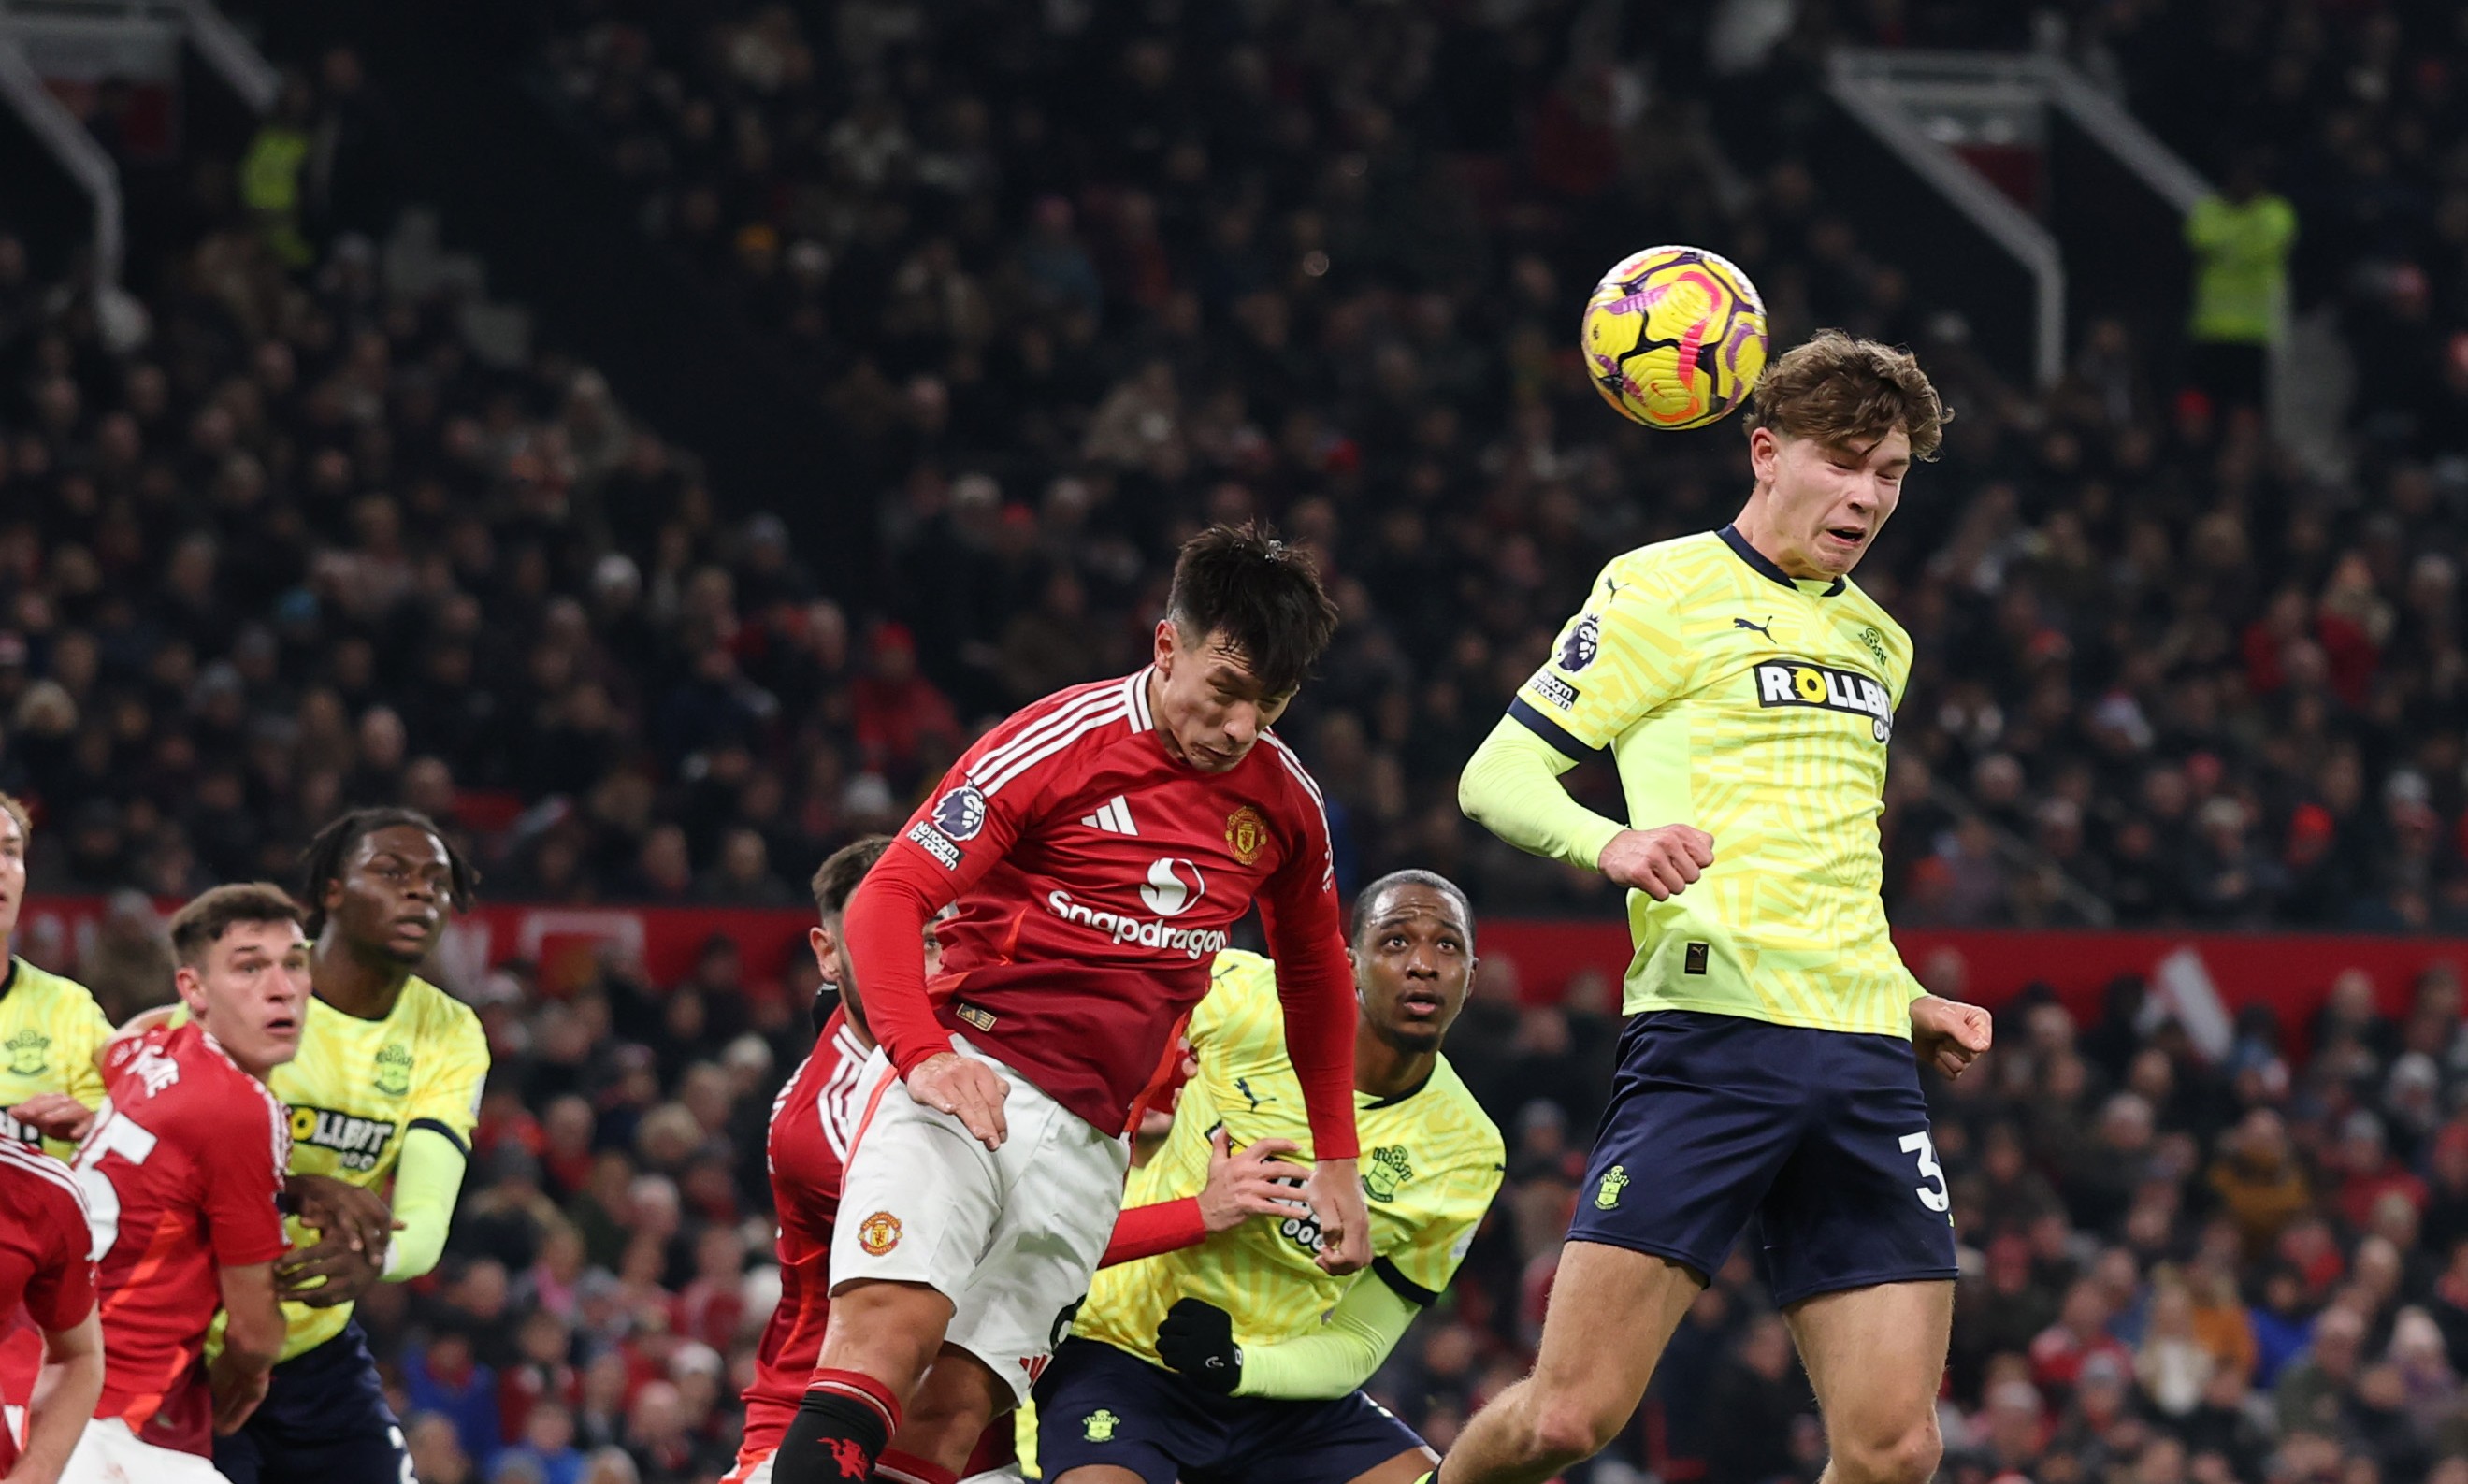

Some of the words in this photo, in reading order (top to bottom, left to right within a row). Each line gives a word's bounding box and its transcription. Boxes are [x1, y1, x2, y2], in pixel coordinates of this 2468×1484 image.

[1537, 684, 1573, 712] racism
[1544, 675, 1573, 699] room
[906, 828, 926, 843] for
[919, 837, 957, 871] racism
[914, 820, 931, 836] No
[927, 829, 960, 859] room
[1046, 890, 1227, 960] Snapdragon
[290, 1106, 393, 1154] OLLBIT
